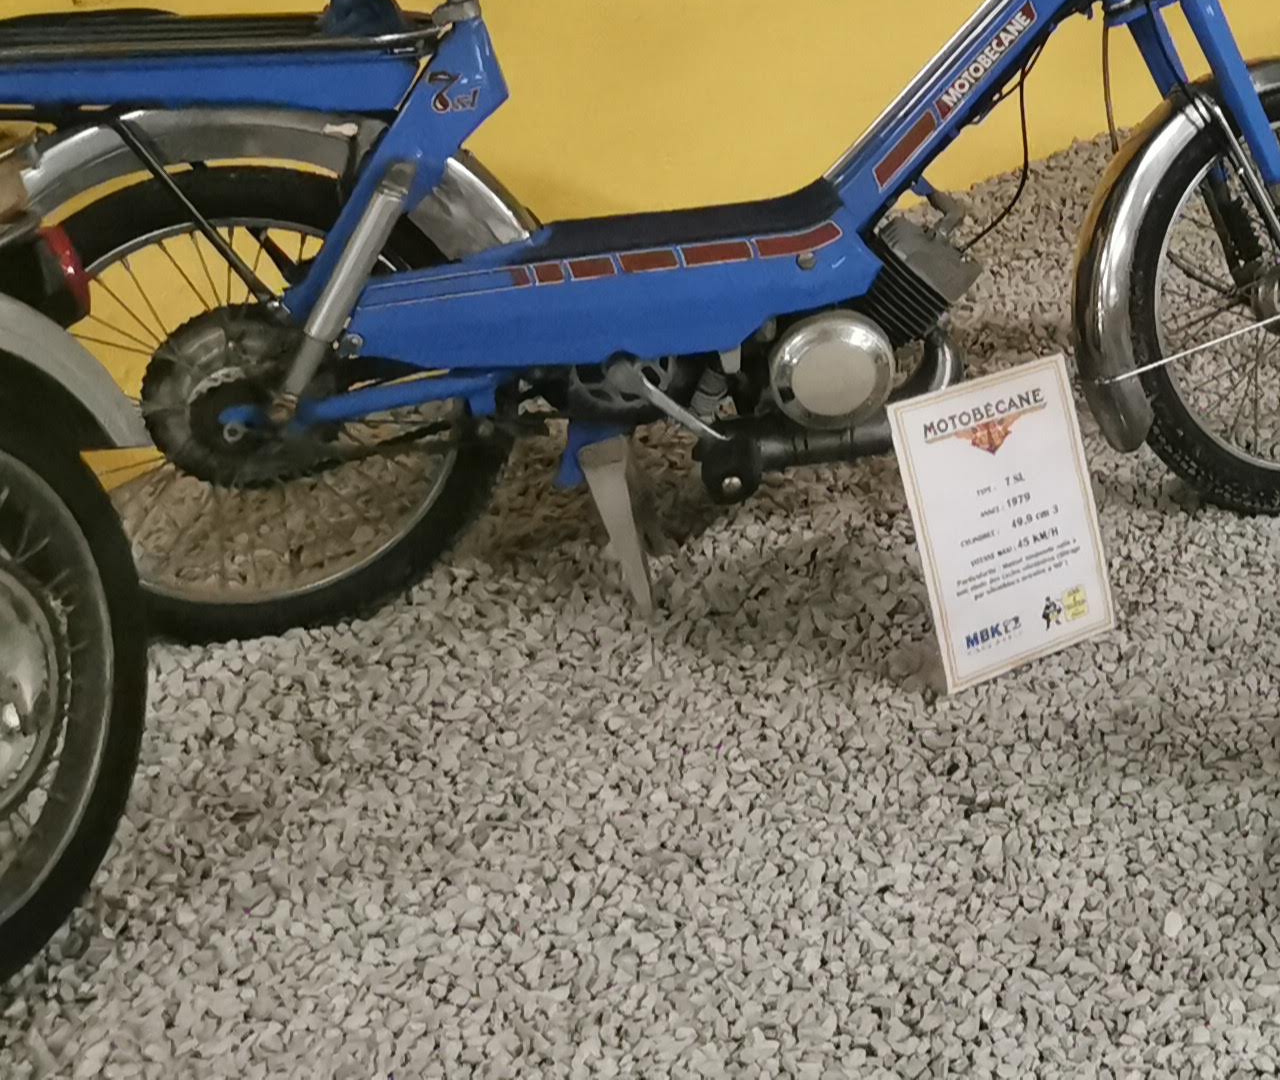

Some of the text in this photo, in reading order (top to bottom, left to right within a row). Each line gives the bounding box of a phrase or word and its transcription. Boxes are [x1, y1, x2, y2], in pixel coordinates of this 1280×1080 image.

[1006, 492, 1031, 509] 1979
[1018, 537, 1031, 550] 45
[965, 623, 1003, 649] MBK
